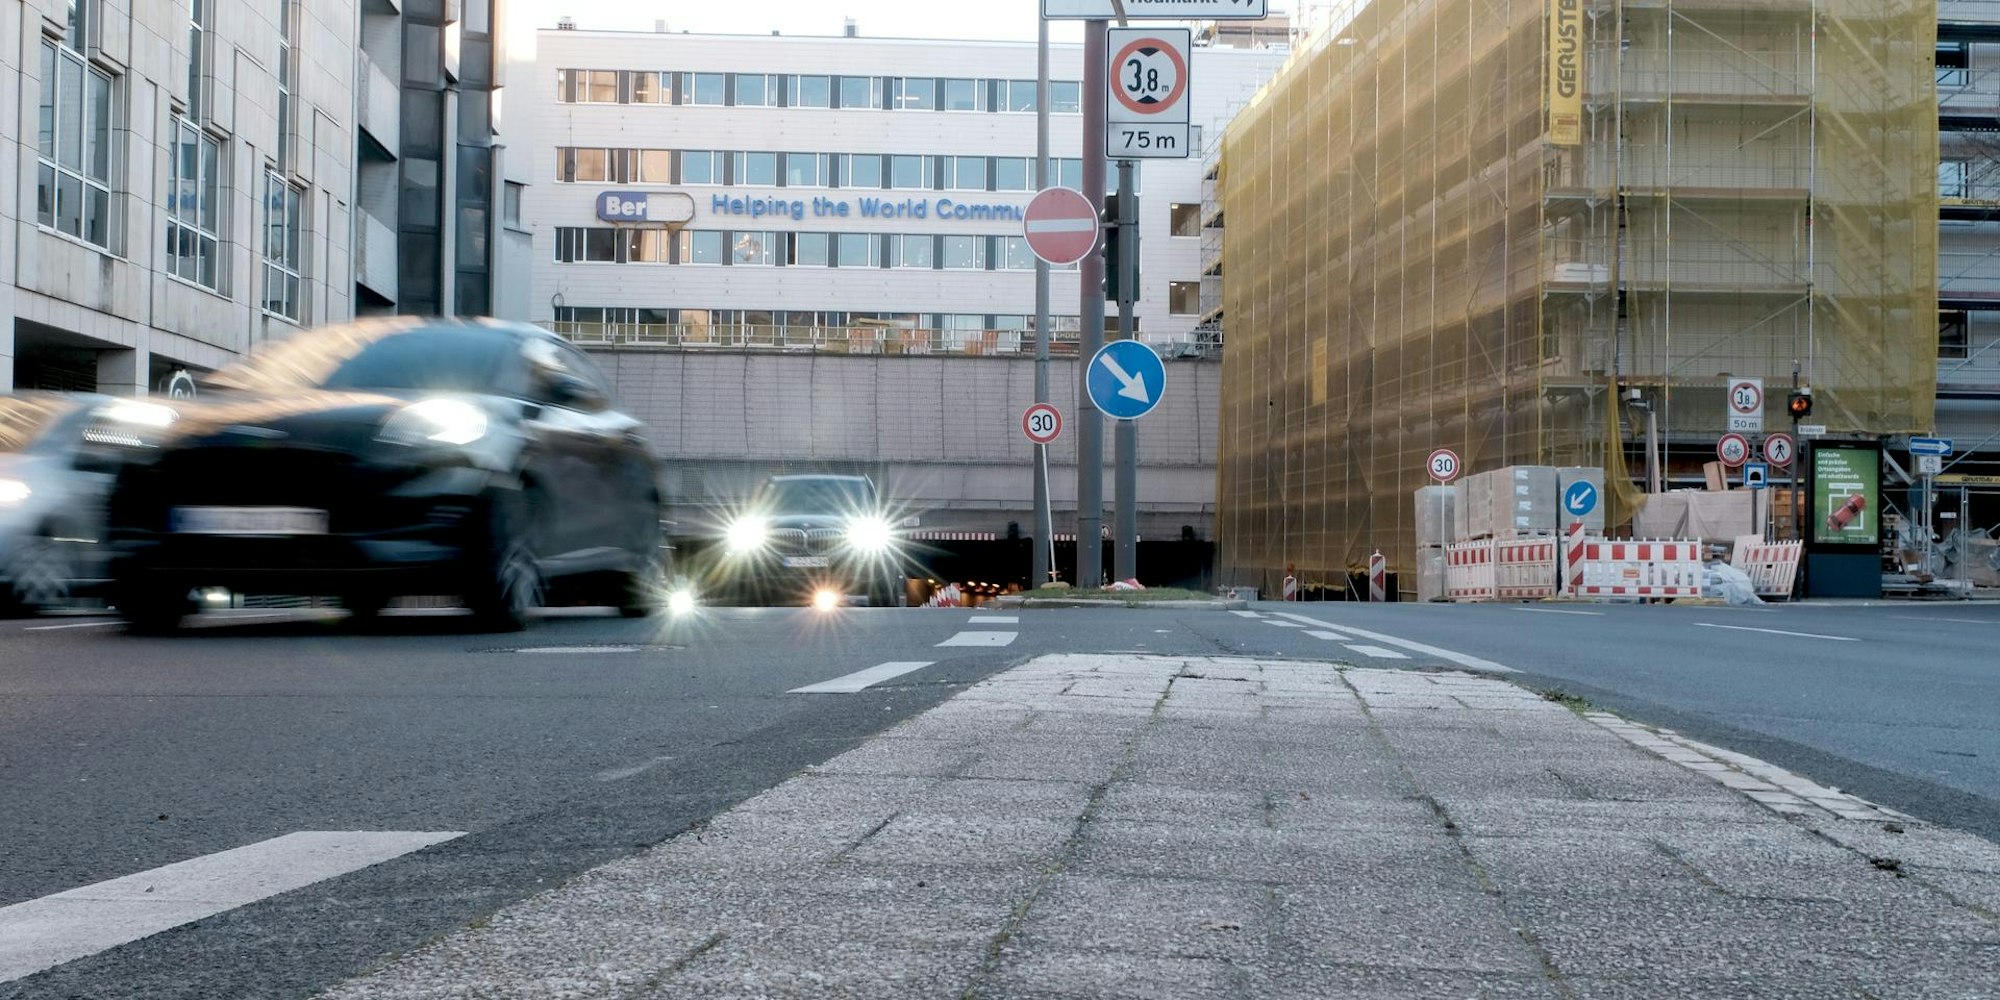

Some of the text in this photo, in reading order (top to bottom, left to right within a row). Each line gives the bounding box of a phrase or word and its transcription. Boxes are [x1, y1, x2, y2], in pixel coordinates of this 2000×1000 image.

[1122, 131, 1175, 148] 75 m
[606, 196, 647, 216] Ber
[711, 194, 804, 220] Helping
[813, 196, 849, 217] the
[858, 197, 927, 219] World
[1031, 414, 1053, 432] 30
[1734, 420, 1747, 428] 50
[1434, 458, 1453, 473] 30
